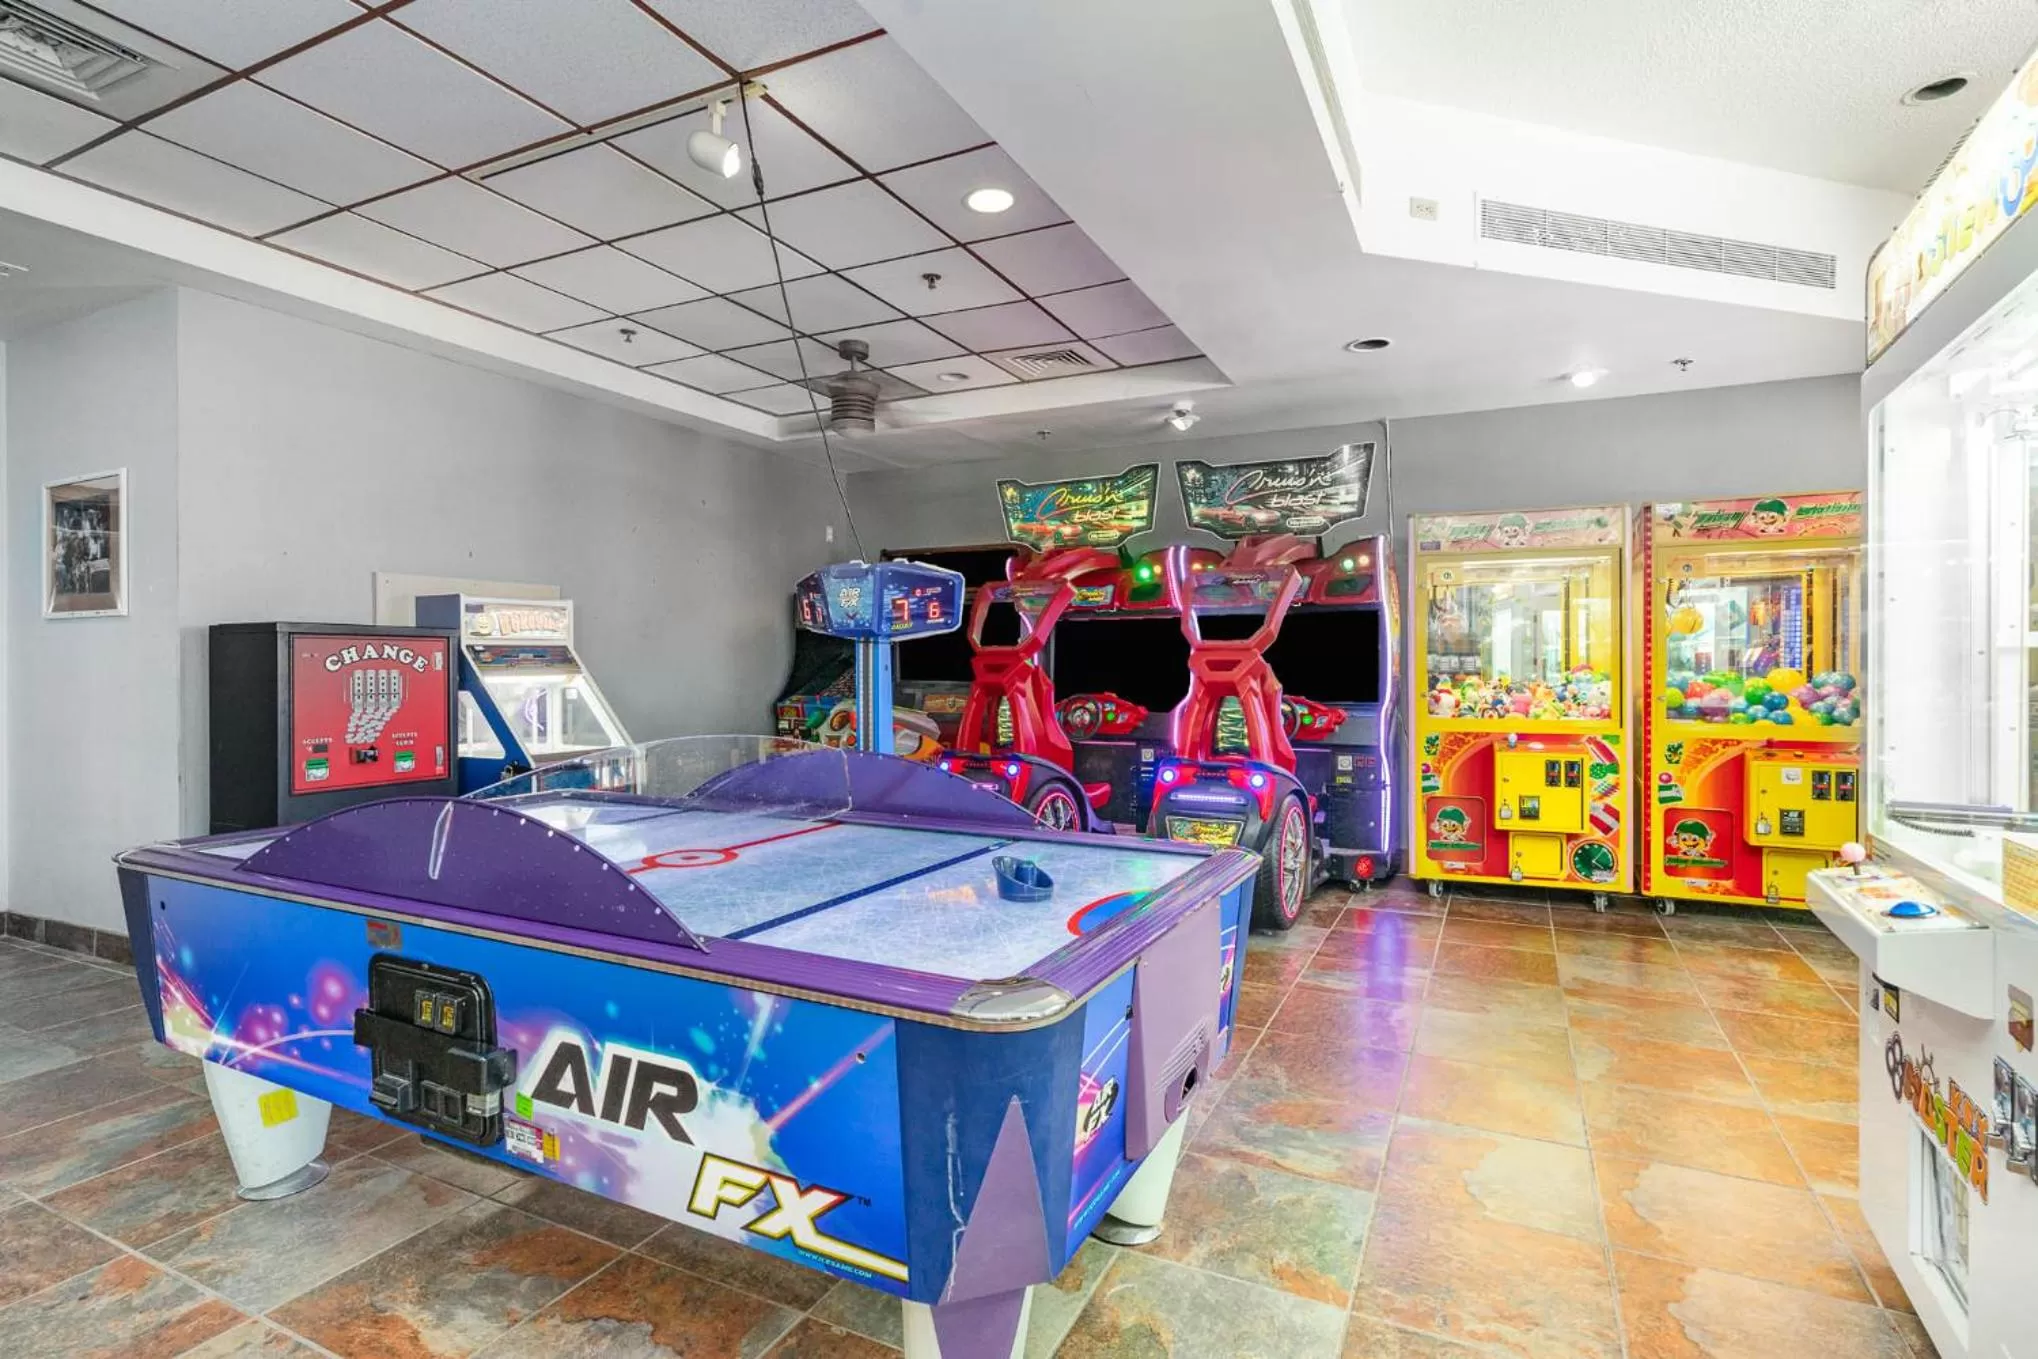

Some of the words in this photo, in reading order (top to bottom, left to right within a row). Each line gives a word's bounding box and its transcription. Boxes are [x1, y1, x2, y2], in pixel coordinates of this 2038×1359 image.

[325, 643, 429, 673] CHANGE
[530, 1040, 699, 1147] AIR
[686, 1152, 909, 1283] FX
